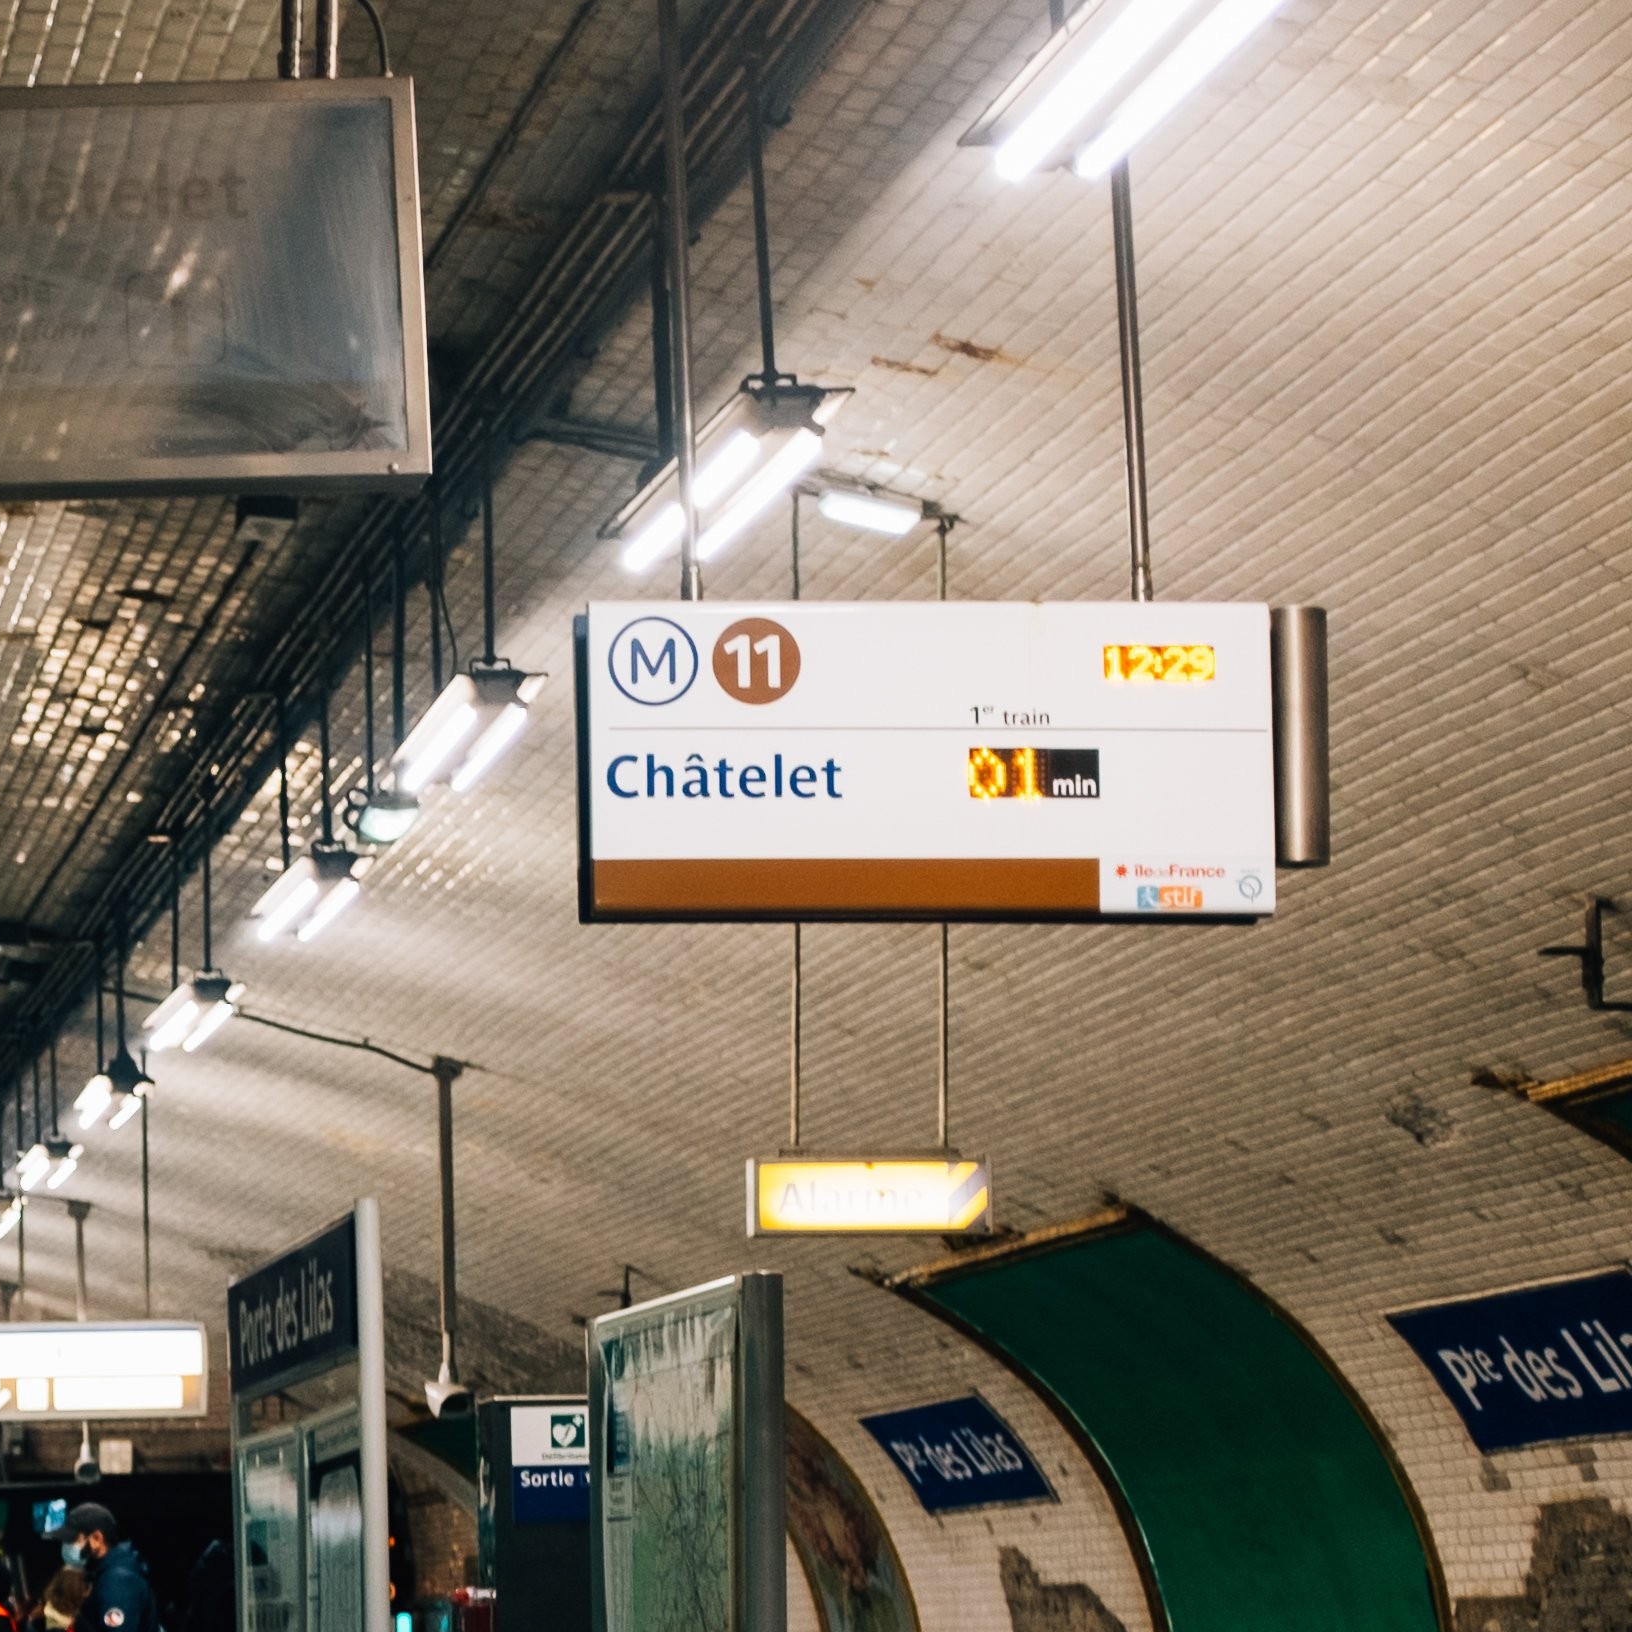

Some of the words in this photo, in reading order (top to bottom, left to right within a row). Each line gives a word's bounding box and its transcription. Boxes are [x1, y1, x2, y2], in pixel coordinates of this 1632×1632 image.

[724, 634, 781, 689] 11
[1104, 645, 1215, 681] 12:29
[1003, 709, 1050, 725] train
[606, 753, 843, 798] Châtelet
[968, 747, 1042, 799] 01
[1053, 774, 1097, 796] min
[239, 1294, 273, 1369] Porte
[276, 1276, 298, 1353] des
[300, 1258, 334, 1341] Lilas
[1438, 1346, 1503, 1410] Pte
[1499, 1335, 1584, 1402] des
[520, 1469, 575, 1488] Sortie
[918, 1433, 972, 1481] des
[951, 1426, 1023, 1475] Lilas
